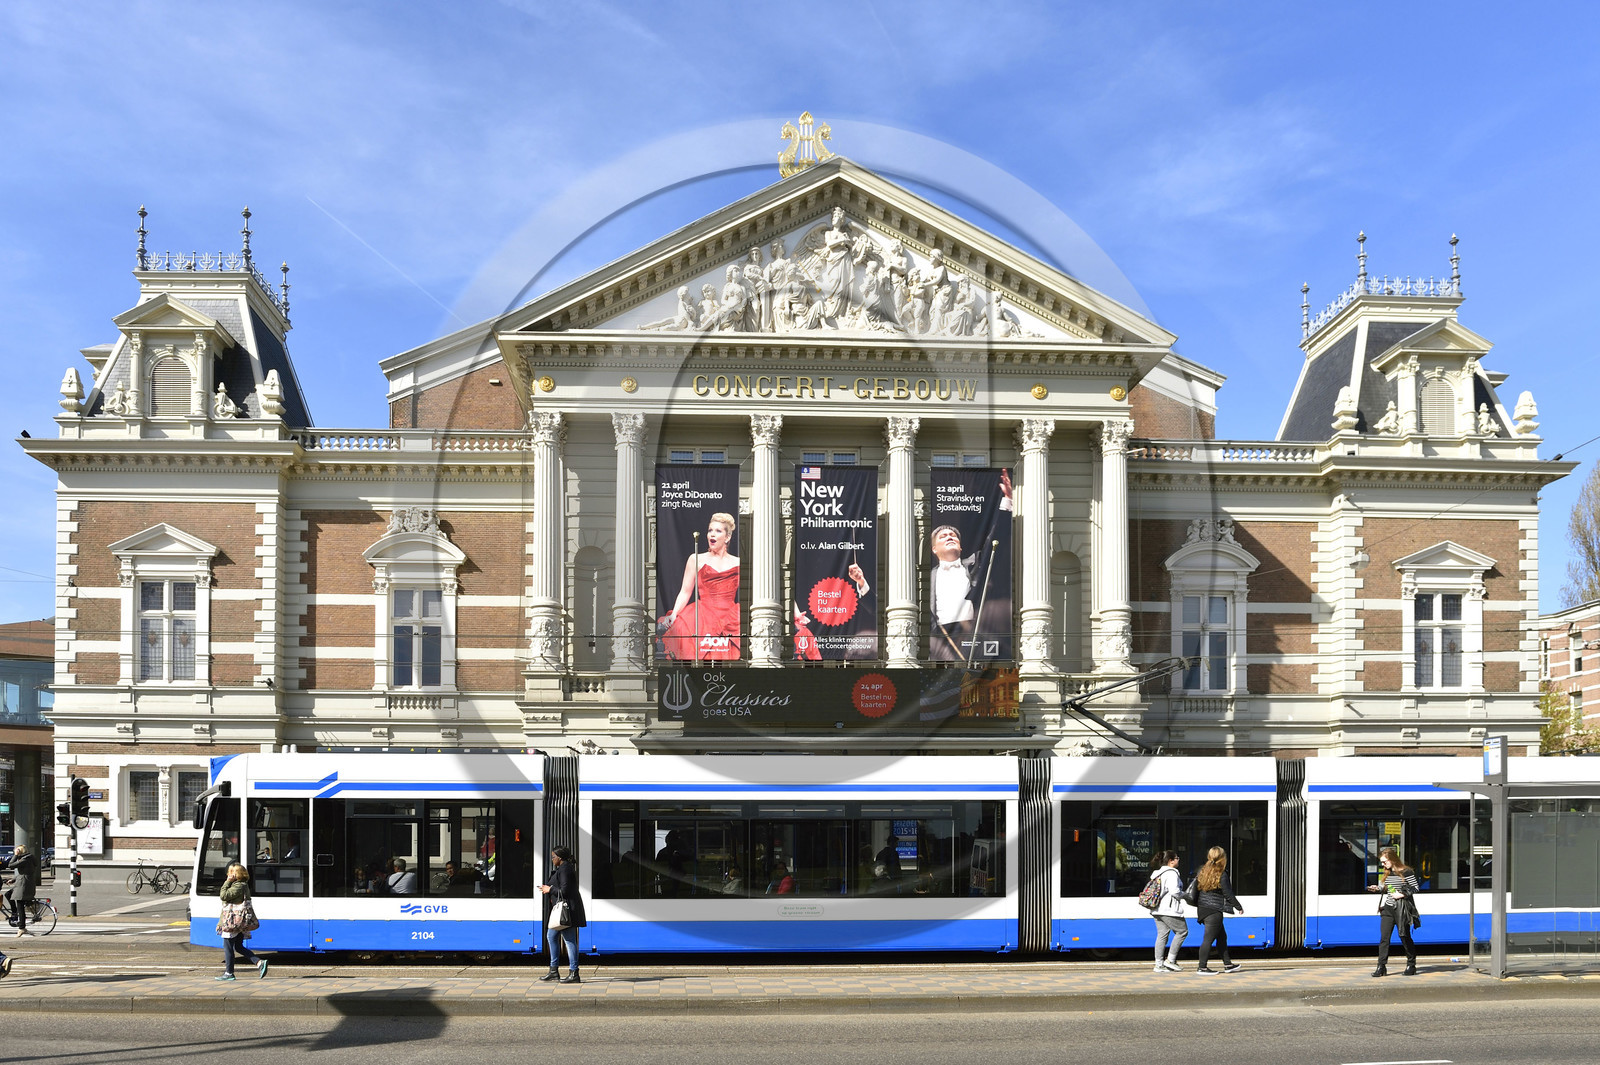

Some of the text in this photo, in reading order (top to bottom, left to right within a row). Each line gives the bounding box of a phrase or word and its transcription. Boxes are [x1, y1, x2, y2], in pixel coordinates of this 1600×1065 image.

[692, 375, 979, 401] CONCERT-GEBOUW
[672, 481, 690, 491] april
[800, 481, 844, 498] New
[947, 484, 965, 494] april
[661, 490, 723, 500] Joyce DiDonato
[936, 494, 974, 504] Stravinsky
[661, 500, 702, 510] zingt Ravel
[800, 498, 844, 516] York
[936, 503, 982, 513] Sjostakovitsj
[800, 517, 873, 528] Philharmonic
[800, 542, 865, 550] o.l.v. Alan Gilbert
[817, 590, 842, 598] Bestel
[817, 605, 847, 613] kaarten
[700, 633, 730, 647] AON
[825, 643, 872, 651] Concertgebouw
[703, 672, 726, 682] Ook
[700, 682, 792, 707] Classics
[703, 707, 752, 718] goes USA
[1127, 860, 1149, 868] water
[424, 905, 448, 913] GVB
[411, 931, 435, 940] 2104
